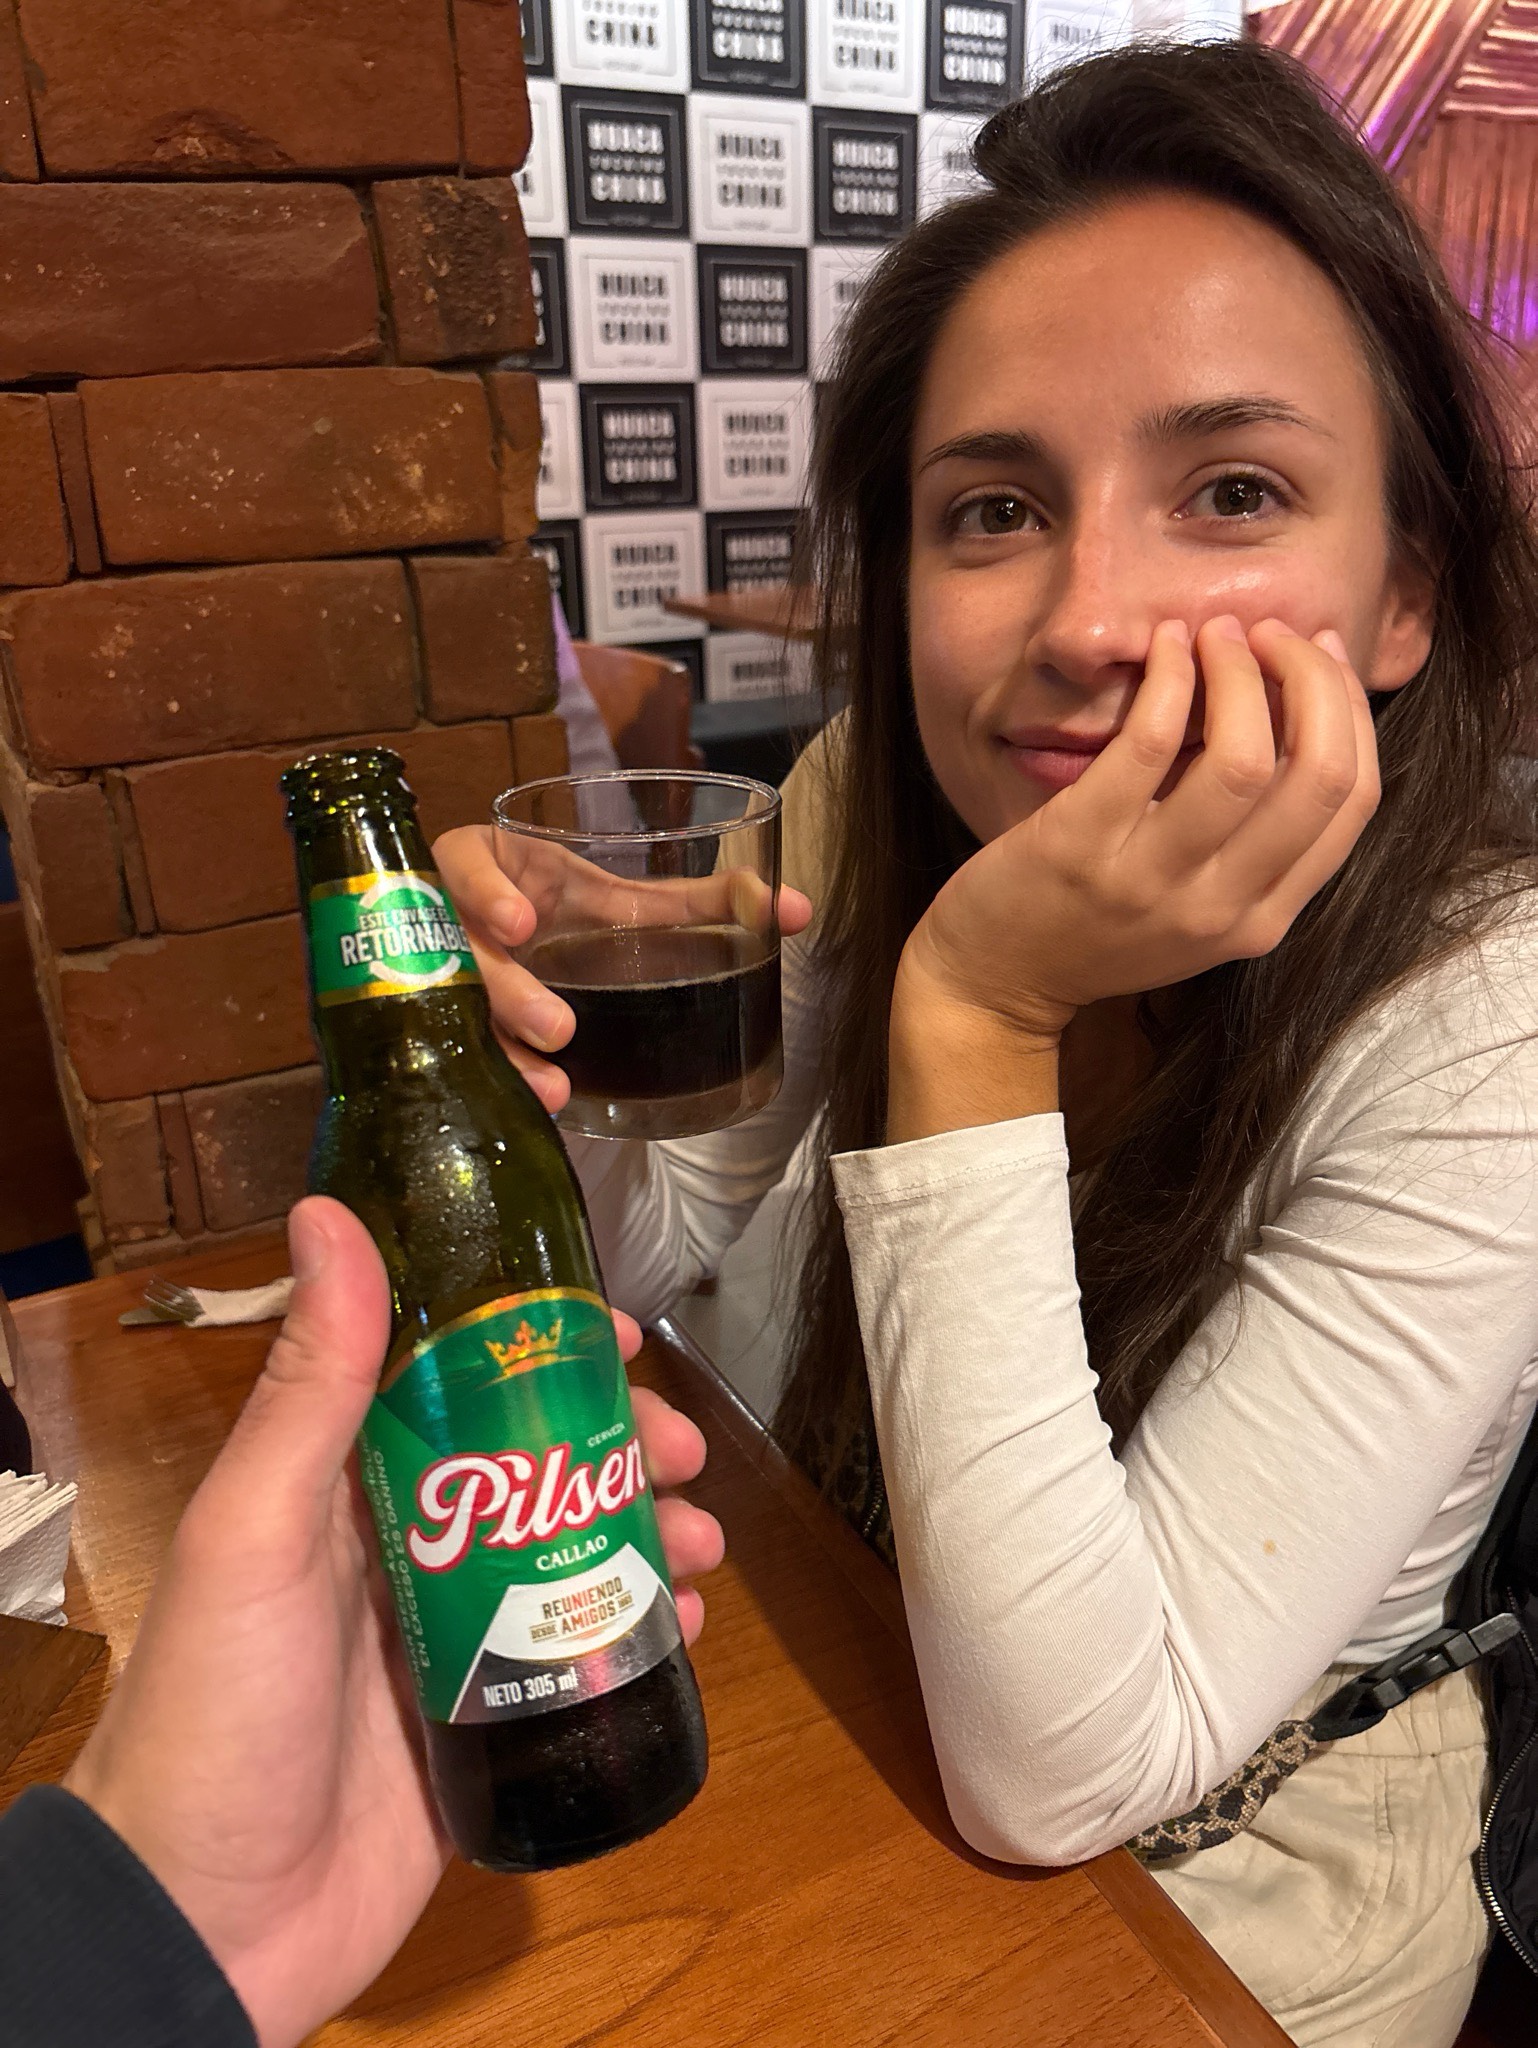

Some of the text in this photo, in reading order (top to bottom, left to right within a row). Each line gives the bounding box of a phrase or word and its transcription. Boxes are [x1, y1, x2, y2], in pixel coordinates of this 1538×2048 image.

[586, 19, 658, 49] CHINA
[713, 28, 784, 62] CHINA
[590, 173, 667, 204] CHINA
[359, 913, 391, 930] ESTE
[391, 909, 437, 926] ENVASE
[341, 926, 472, 965] RETORNABLE
[408, 1439, 646, 1571] Pilsen
[535, 1533, 609, 1572] CALLAO
[398, 1559, 424, 1636] EXCESO
[541, 1576, 623, 1620] REUNIENDO
[530, 1623, 557, 1641] DESDE
[561, 1599, 617, 1635] AMIGOS
[417, 1641, 431, 1667] EN
[482, 1681, 523, 1708] NETO
[525, 1673, 557, 1702] 305
